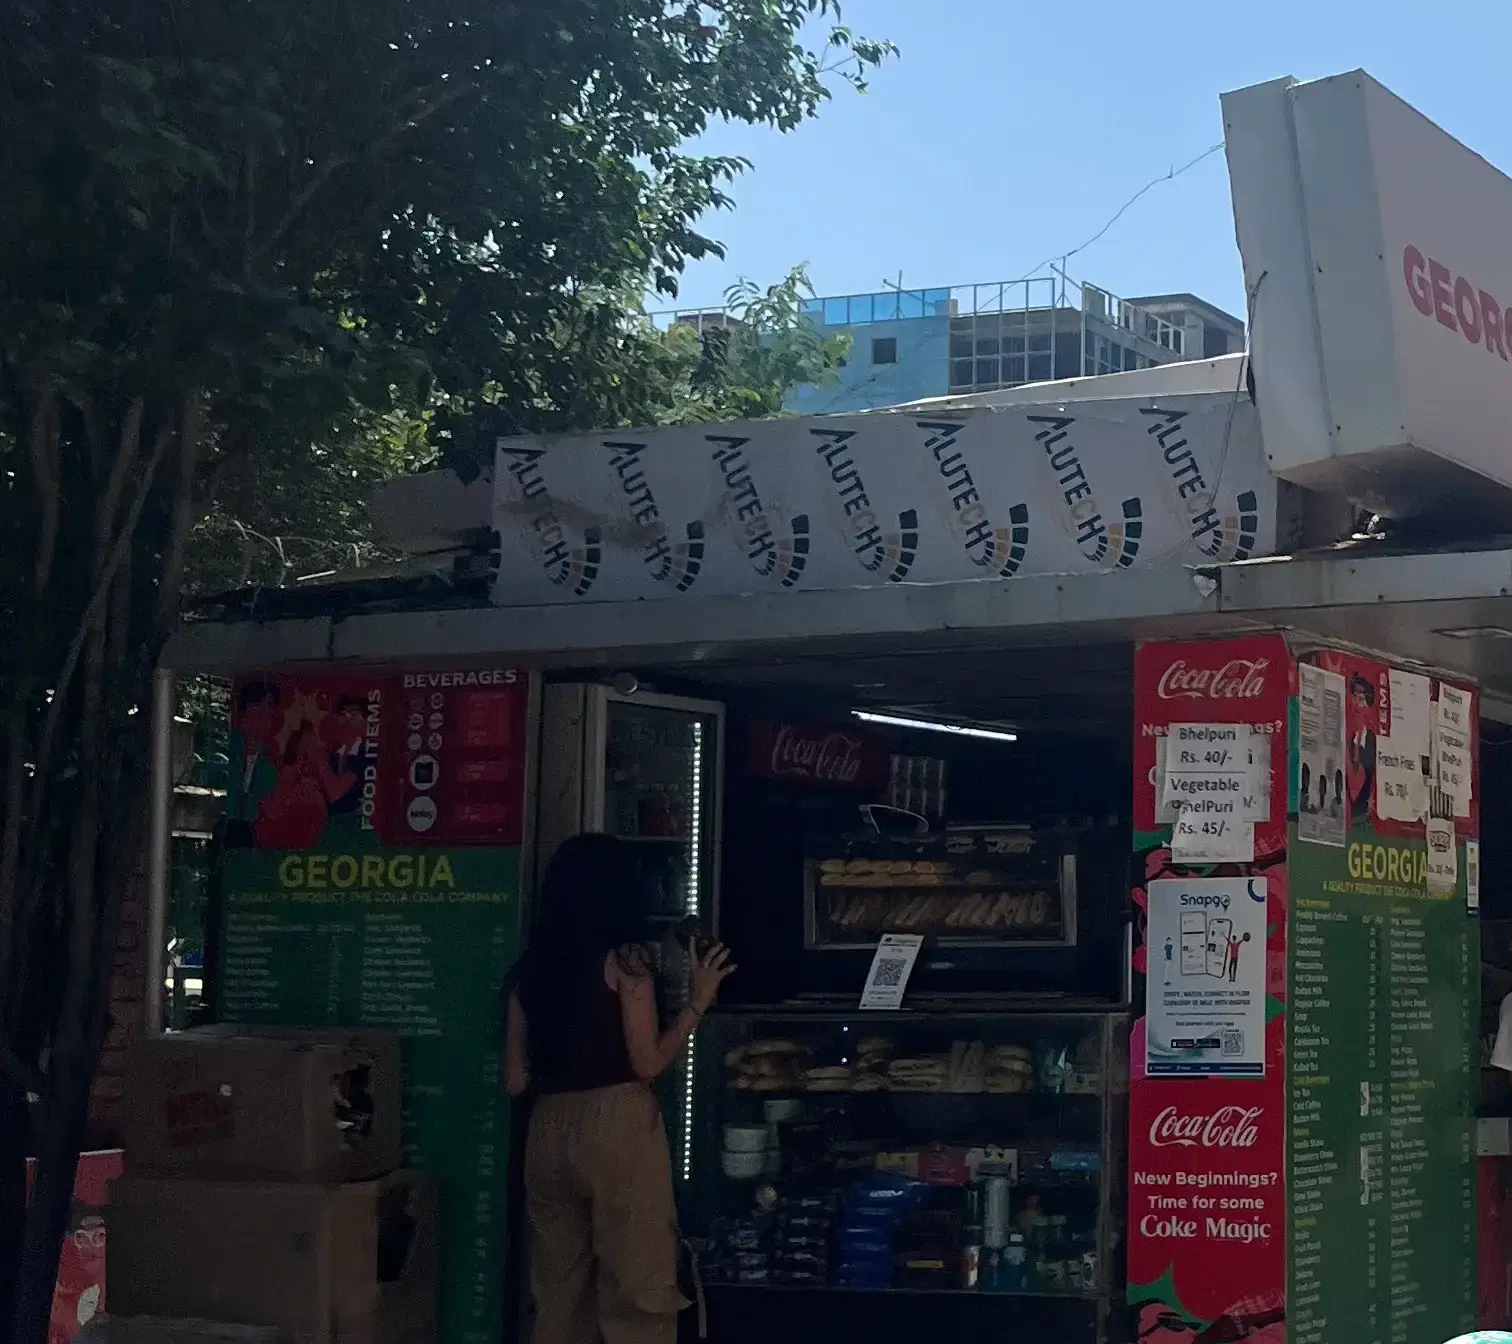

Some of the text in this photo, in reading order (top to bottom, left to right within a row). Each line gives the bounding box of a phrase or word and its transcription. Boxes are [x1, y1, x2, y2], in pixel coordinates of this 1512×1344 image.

[916, 421, 993, 549] ALUTECH
[1027, 415, 1105, 543] ALUTECH
[1139, 408, 1220, 539] ALUTECH
[501, 447, 571, 567] ALUECH
[602, 441, 670, 563] ALUTEH
[810, 428, 881, 553] ALUTECH
[404, 669, 517, 688] BEVERAGES
[1179, 727, 1236, 742] Bhelpuri
[360, 688, 382, 830] FOOD ITEMS
[1180, 749, 1233, 766] Rs. 40/-
[1170, 778, 1240, 794] Vegetable
[1179, 820, 1230, 837] Rs. 45/-
[278, 855, 456, 888] GEORGIA
[1348, 843, 1429, 884] GEORGIA
[1134, 1171, 1277, 1189] New Beginnings?
[1148, 1196, 1264, 1210] Time for some
[1140, 1215, 1271, 1244] Coke Magic
